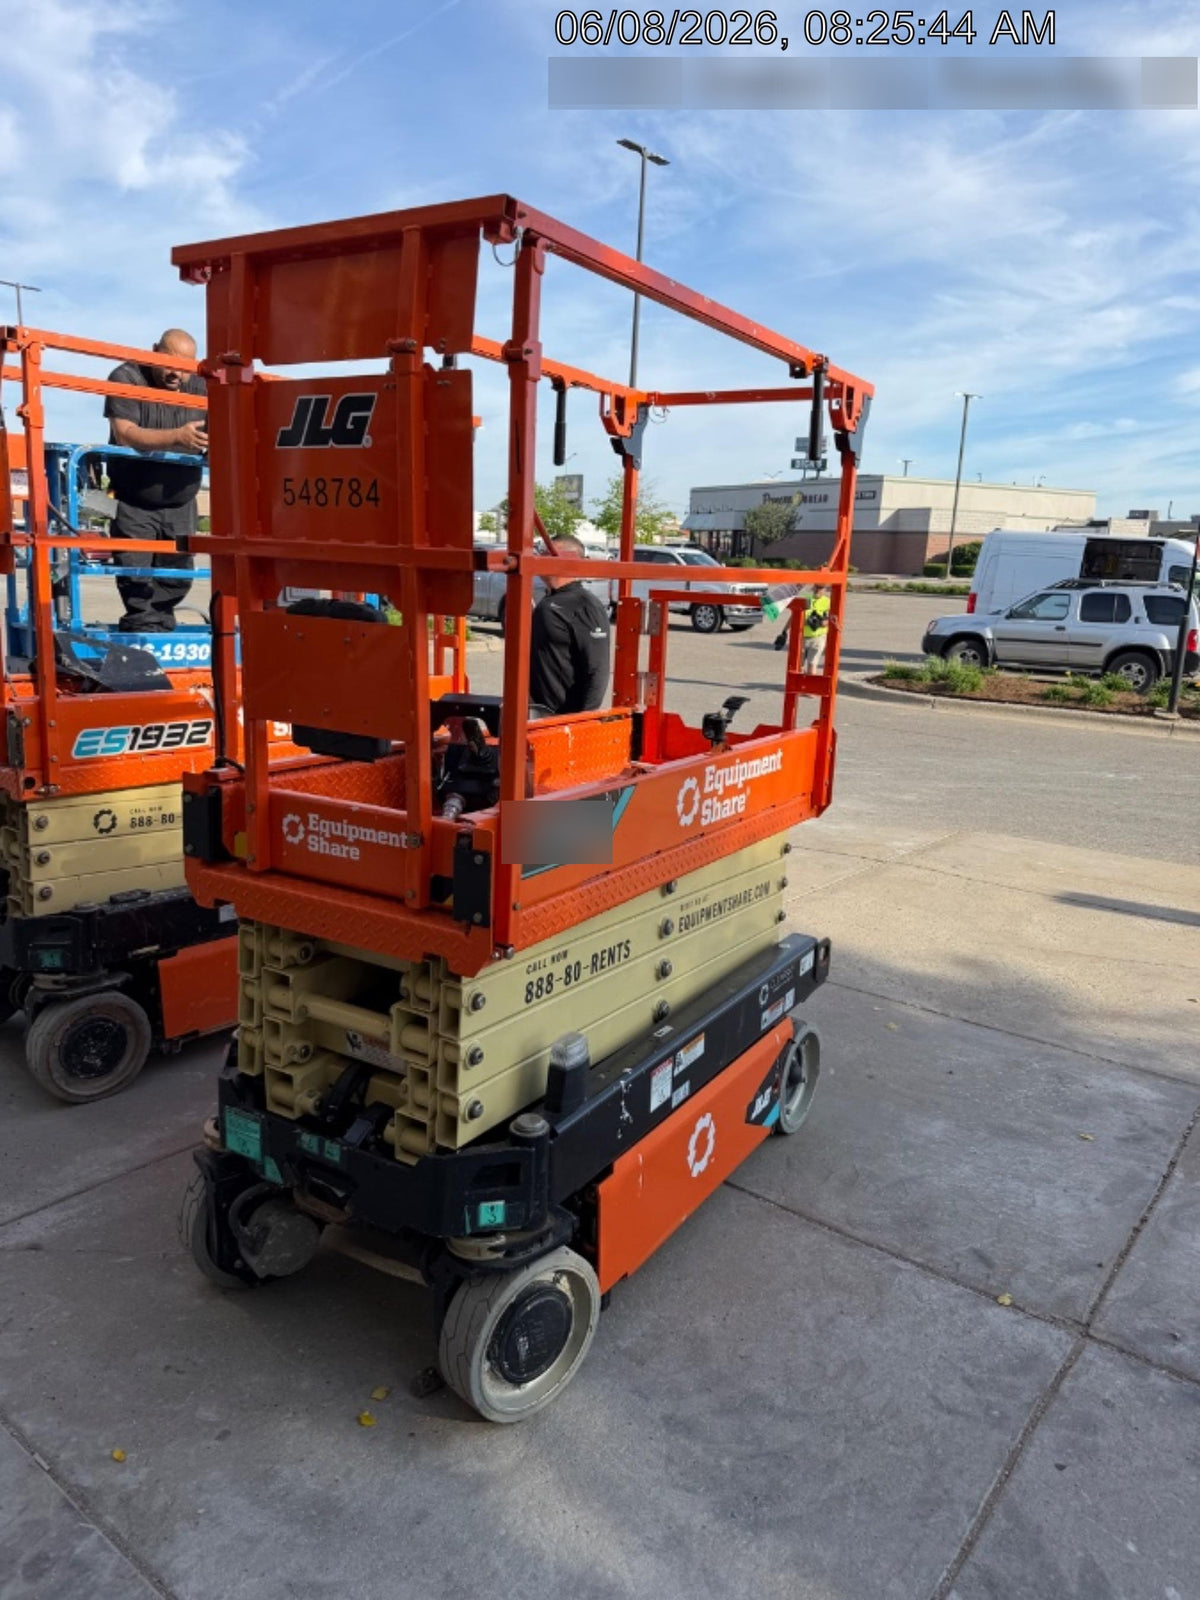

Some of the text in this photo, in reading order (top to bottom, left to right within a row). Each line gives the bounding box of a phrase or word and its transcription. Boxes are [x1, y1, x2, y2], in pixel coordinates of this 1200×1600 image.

[275, 393, 378, 449] JLG
[283, 477, 381, 508] 548784
[73, 720, 213, 758] ES1932
[703, 748, 783, 796] Equipment
[130, 812, 182, 829] 888-80-
[701, 793, 746, 826] Share
[307, 813, 408, 848] Equipment
[307, 834, 360, 860] Share
[524, 939, 631, 1004] 888-80-RENTS
[526, 949, 568, 975] CALL NOW
